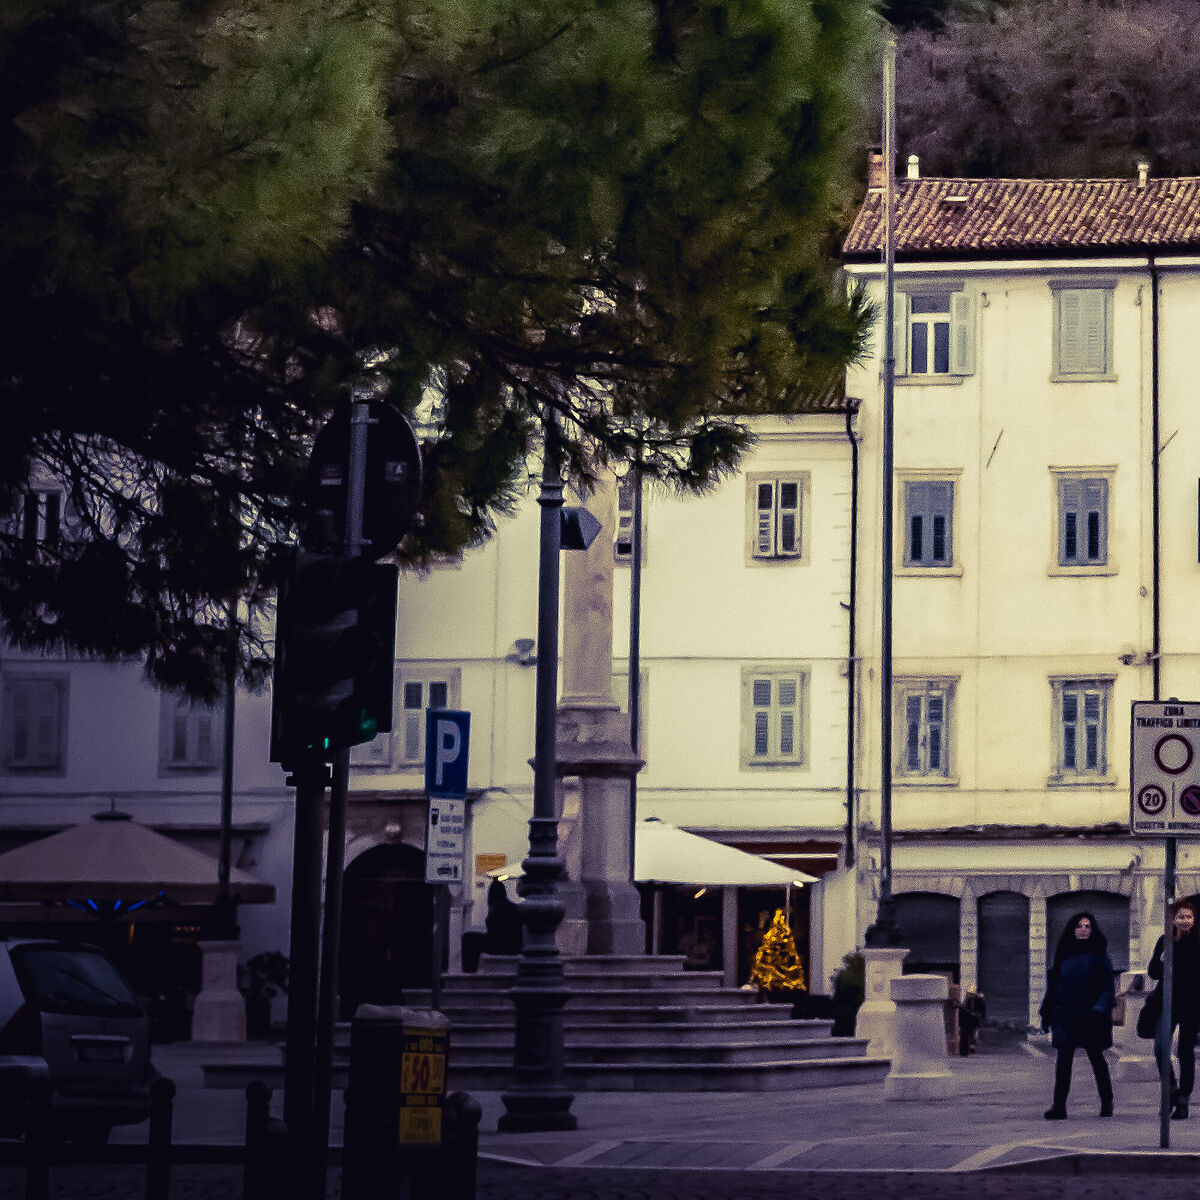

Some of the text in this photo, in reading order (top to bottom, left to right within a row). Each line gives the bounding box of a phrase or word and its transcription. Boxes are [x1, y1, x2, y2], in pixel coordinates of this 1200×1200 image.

[1164, 706, 1184, 716] ZONA
[1136, 717, 1173, 728] TRAFFICO
[435, 719, 461, 786] P
[1144, 793, 1160, 806] 20
